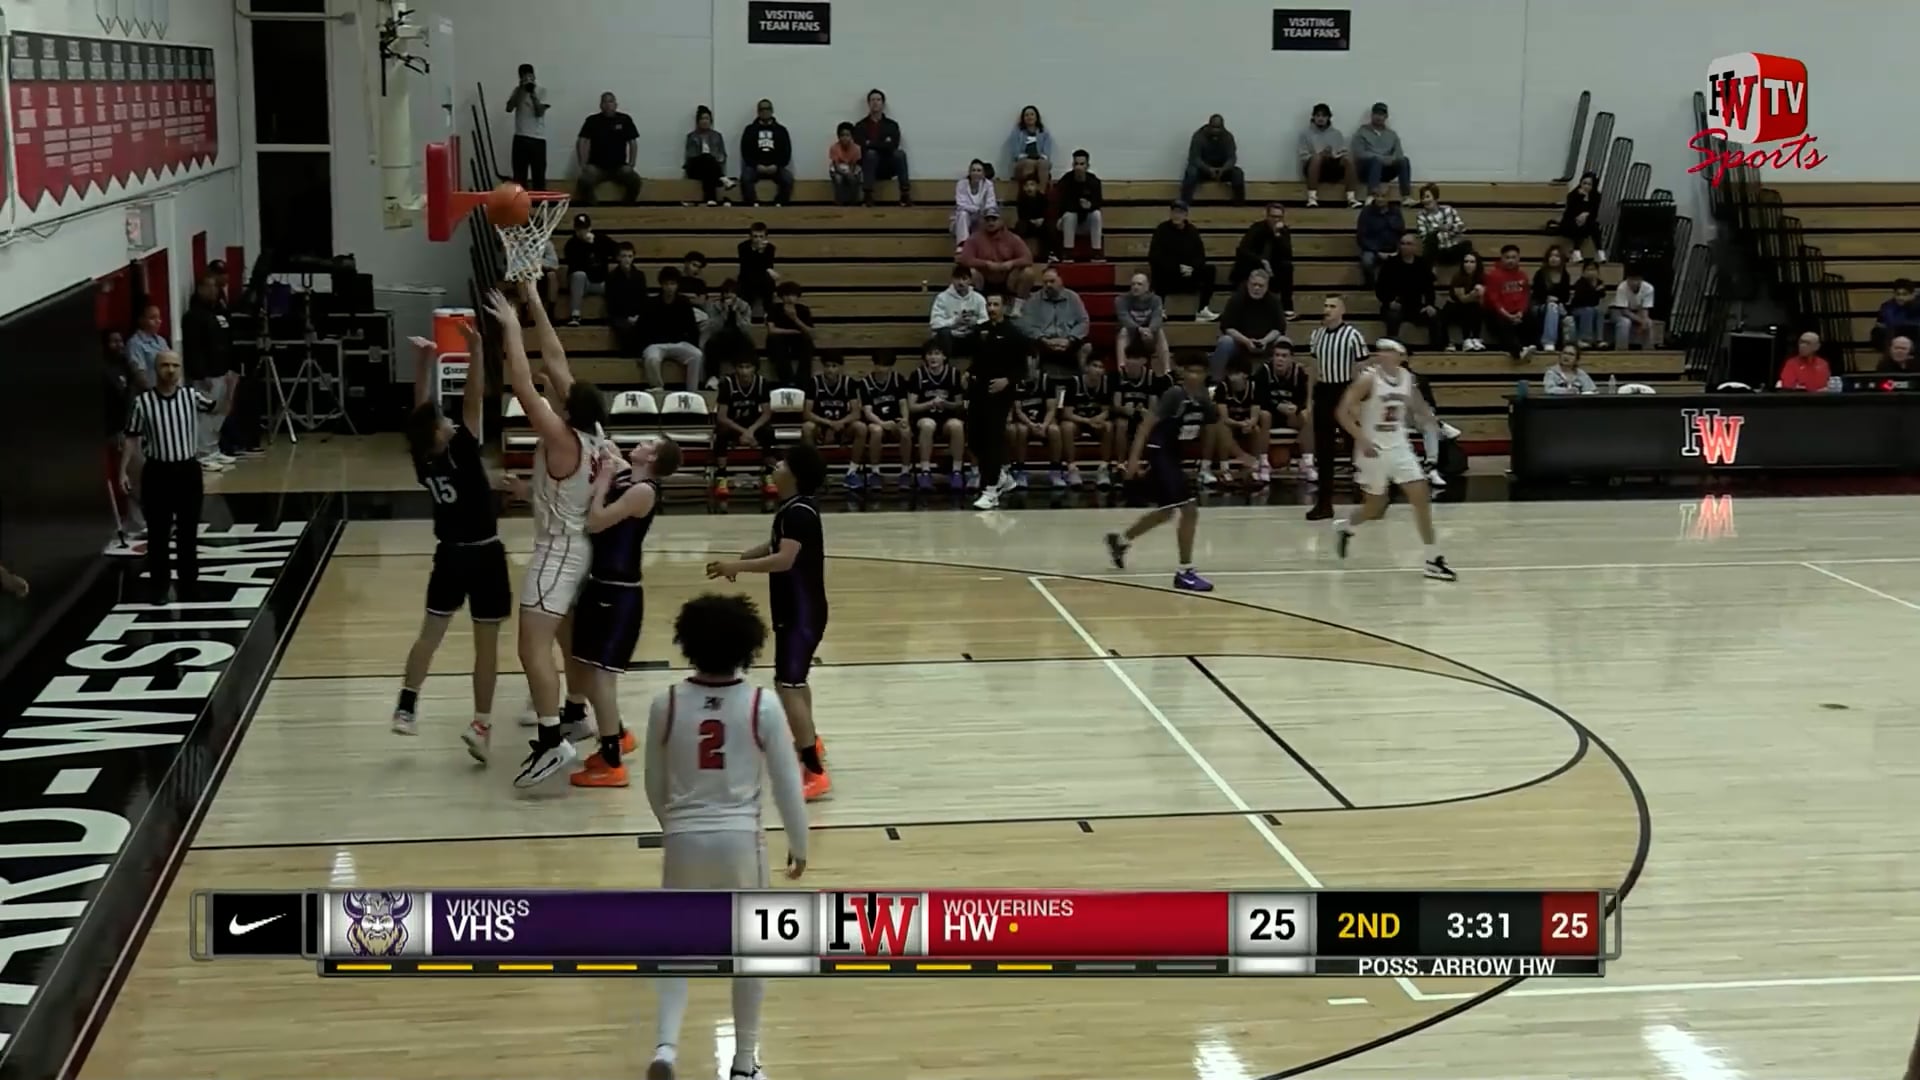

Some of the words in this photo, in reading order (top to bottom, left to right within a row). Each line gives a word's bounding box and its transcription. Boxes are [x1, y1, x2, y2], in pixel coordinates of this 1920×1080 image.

[765, 10, 814, 20] VISITING
[759, 20, 790, 31] TEAM
[792, 21, 821, 31] FANS
[1288, 17, 1335, 27] VISITING
[1282, 27, 1312, 37] TEAM
[1313, 28, 1341, 38] FANS
[1681, 408, 1744, 464] HW
[425, 476, 457, 504] 15
[698, 719, 725, 770] 2
